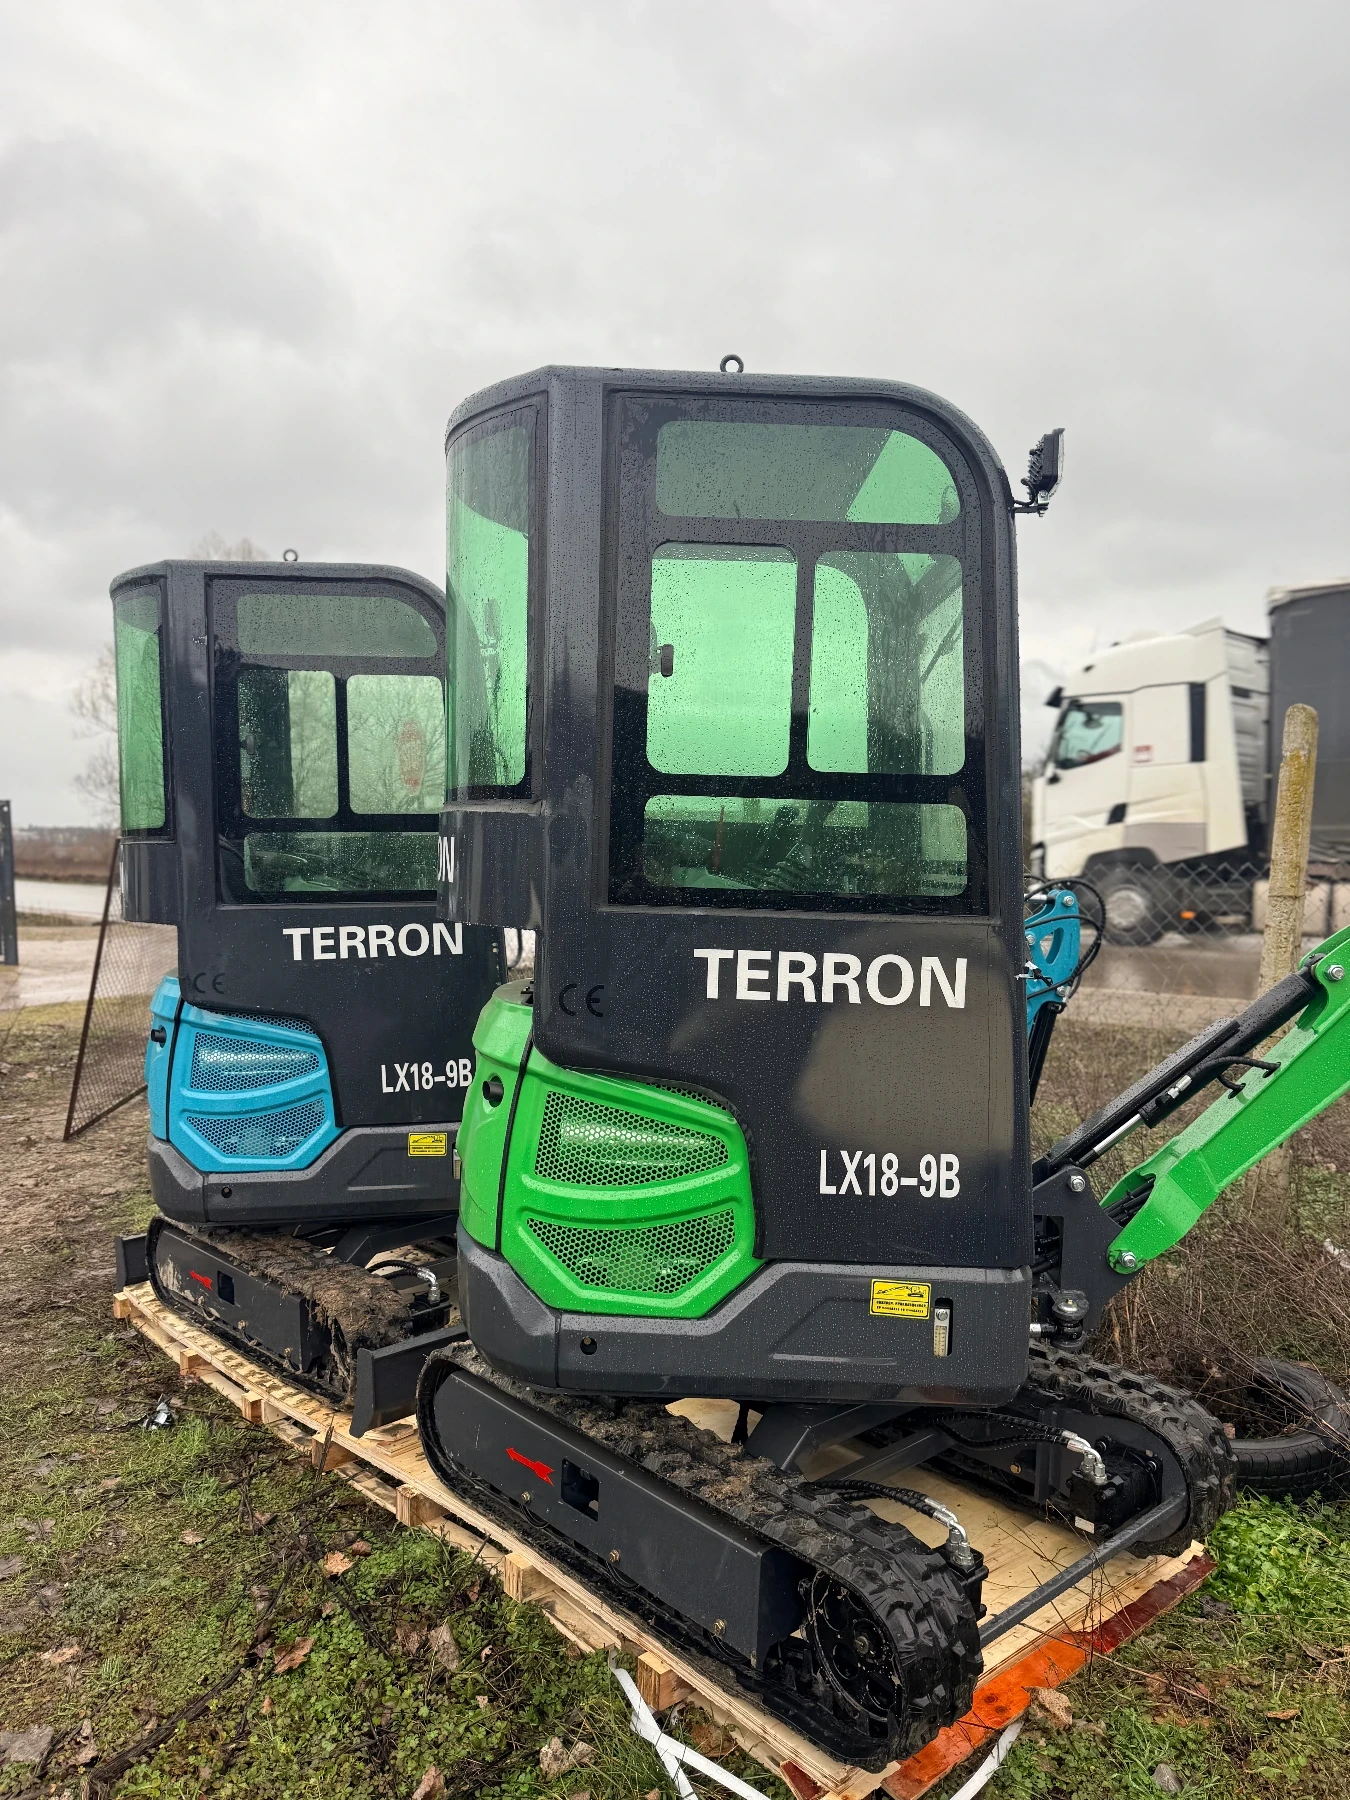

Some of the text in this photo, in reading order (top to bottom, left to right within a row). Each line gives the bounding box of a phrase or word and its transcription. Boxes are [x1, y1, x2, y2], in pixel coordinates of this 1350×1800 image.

[283, 922, 464, 961] TERRON
[193, 972, 226, 994] CE
[694, 948, 968, 1009] TERRON
[558, 983, 605, 1017] CE
[381, 1058, 473, 1093] LX18-9B
[819, 1149, 961, 1199] LX18-9B
